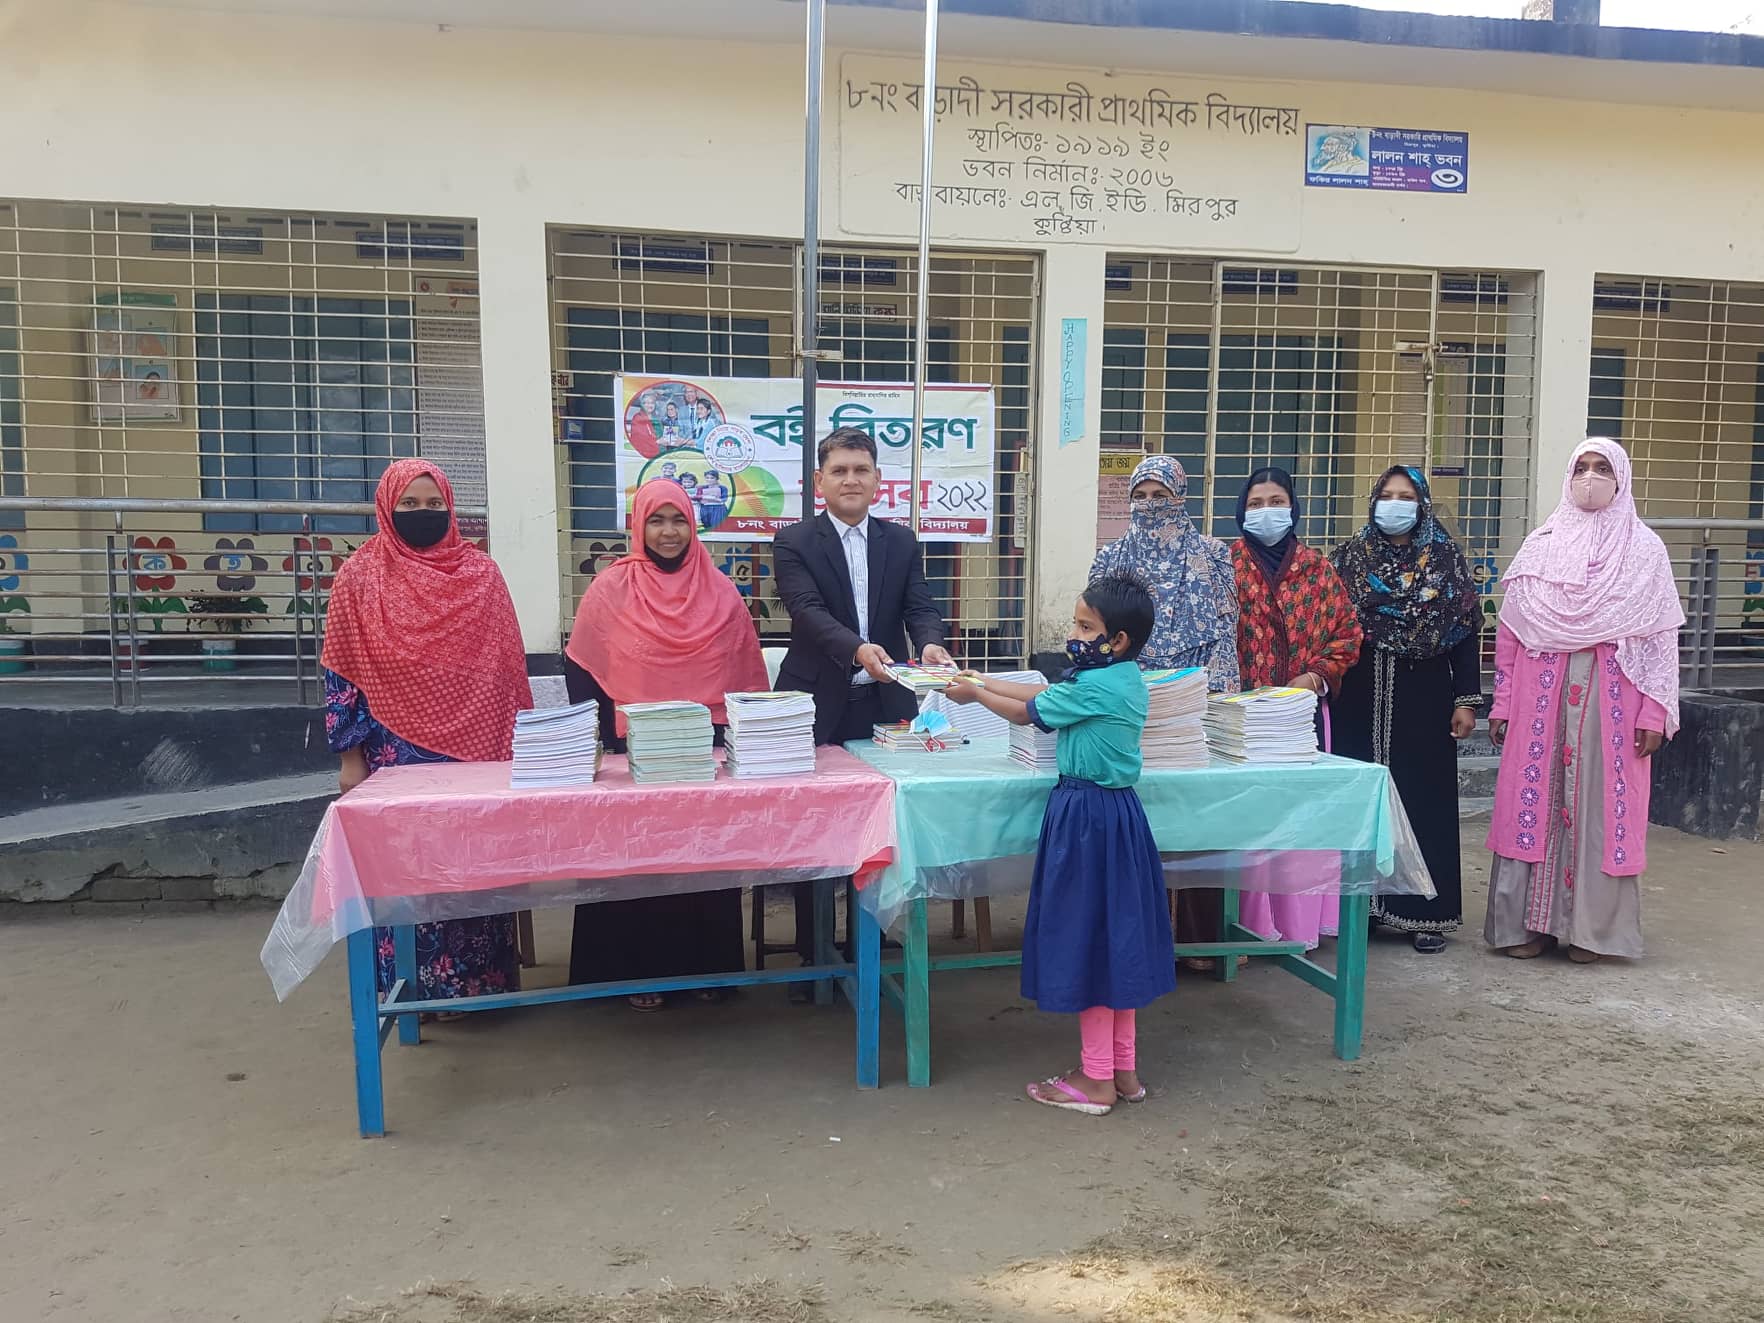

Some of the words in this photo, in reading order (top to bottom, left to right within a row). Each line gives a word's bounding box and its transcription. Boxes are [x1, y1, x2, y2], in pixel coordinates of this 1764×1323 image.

[991, 82, 1094, 123] সরকারী
[1098, 88, 1199, 128] প্রাথমিক
[1205, 93, 1300, 136] বিদ্যালয়
[1371, 150, 1404, 164] লালন
[1434, 154, 1463, 168] ভবন
[963, 160, 1015, 179] ভবন
[1110, 167, 1174, 188] ২০০৬
[937, 481, 988, 512] ২০২২
[737, 519, 766, 529] ৮নং
[919, 518, 970, 530] বিদ্যালয়
